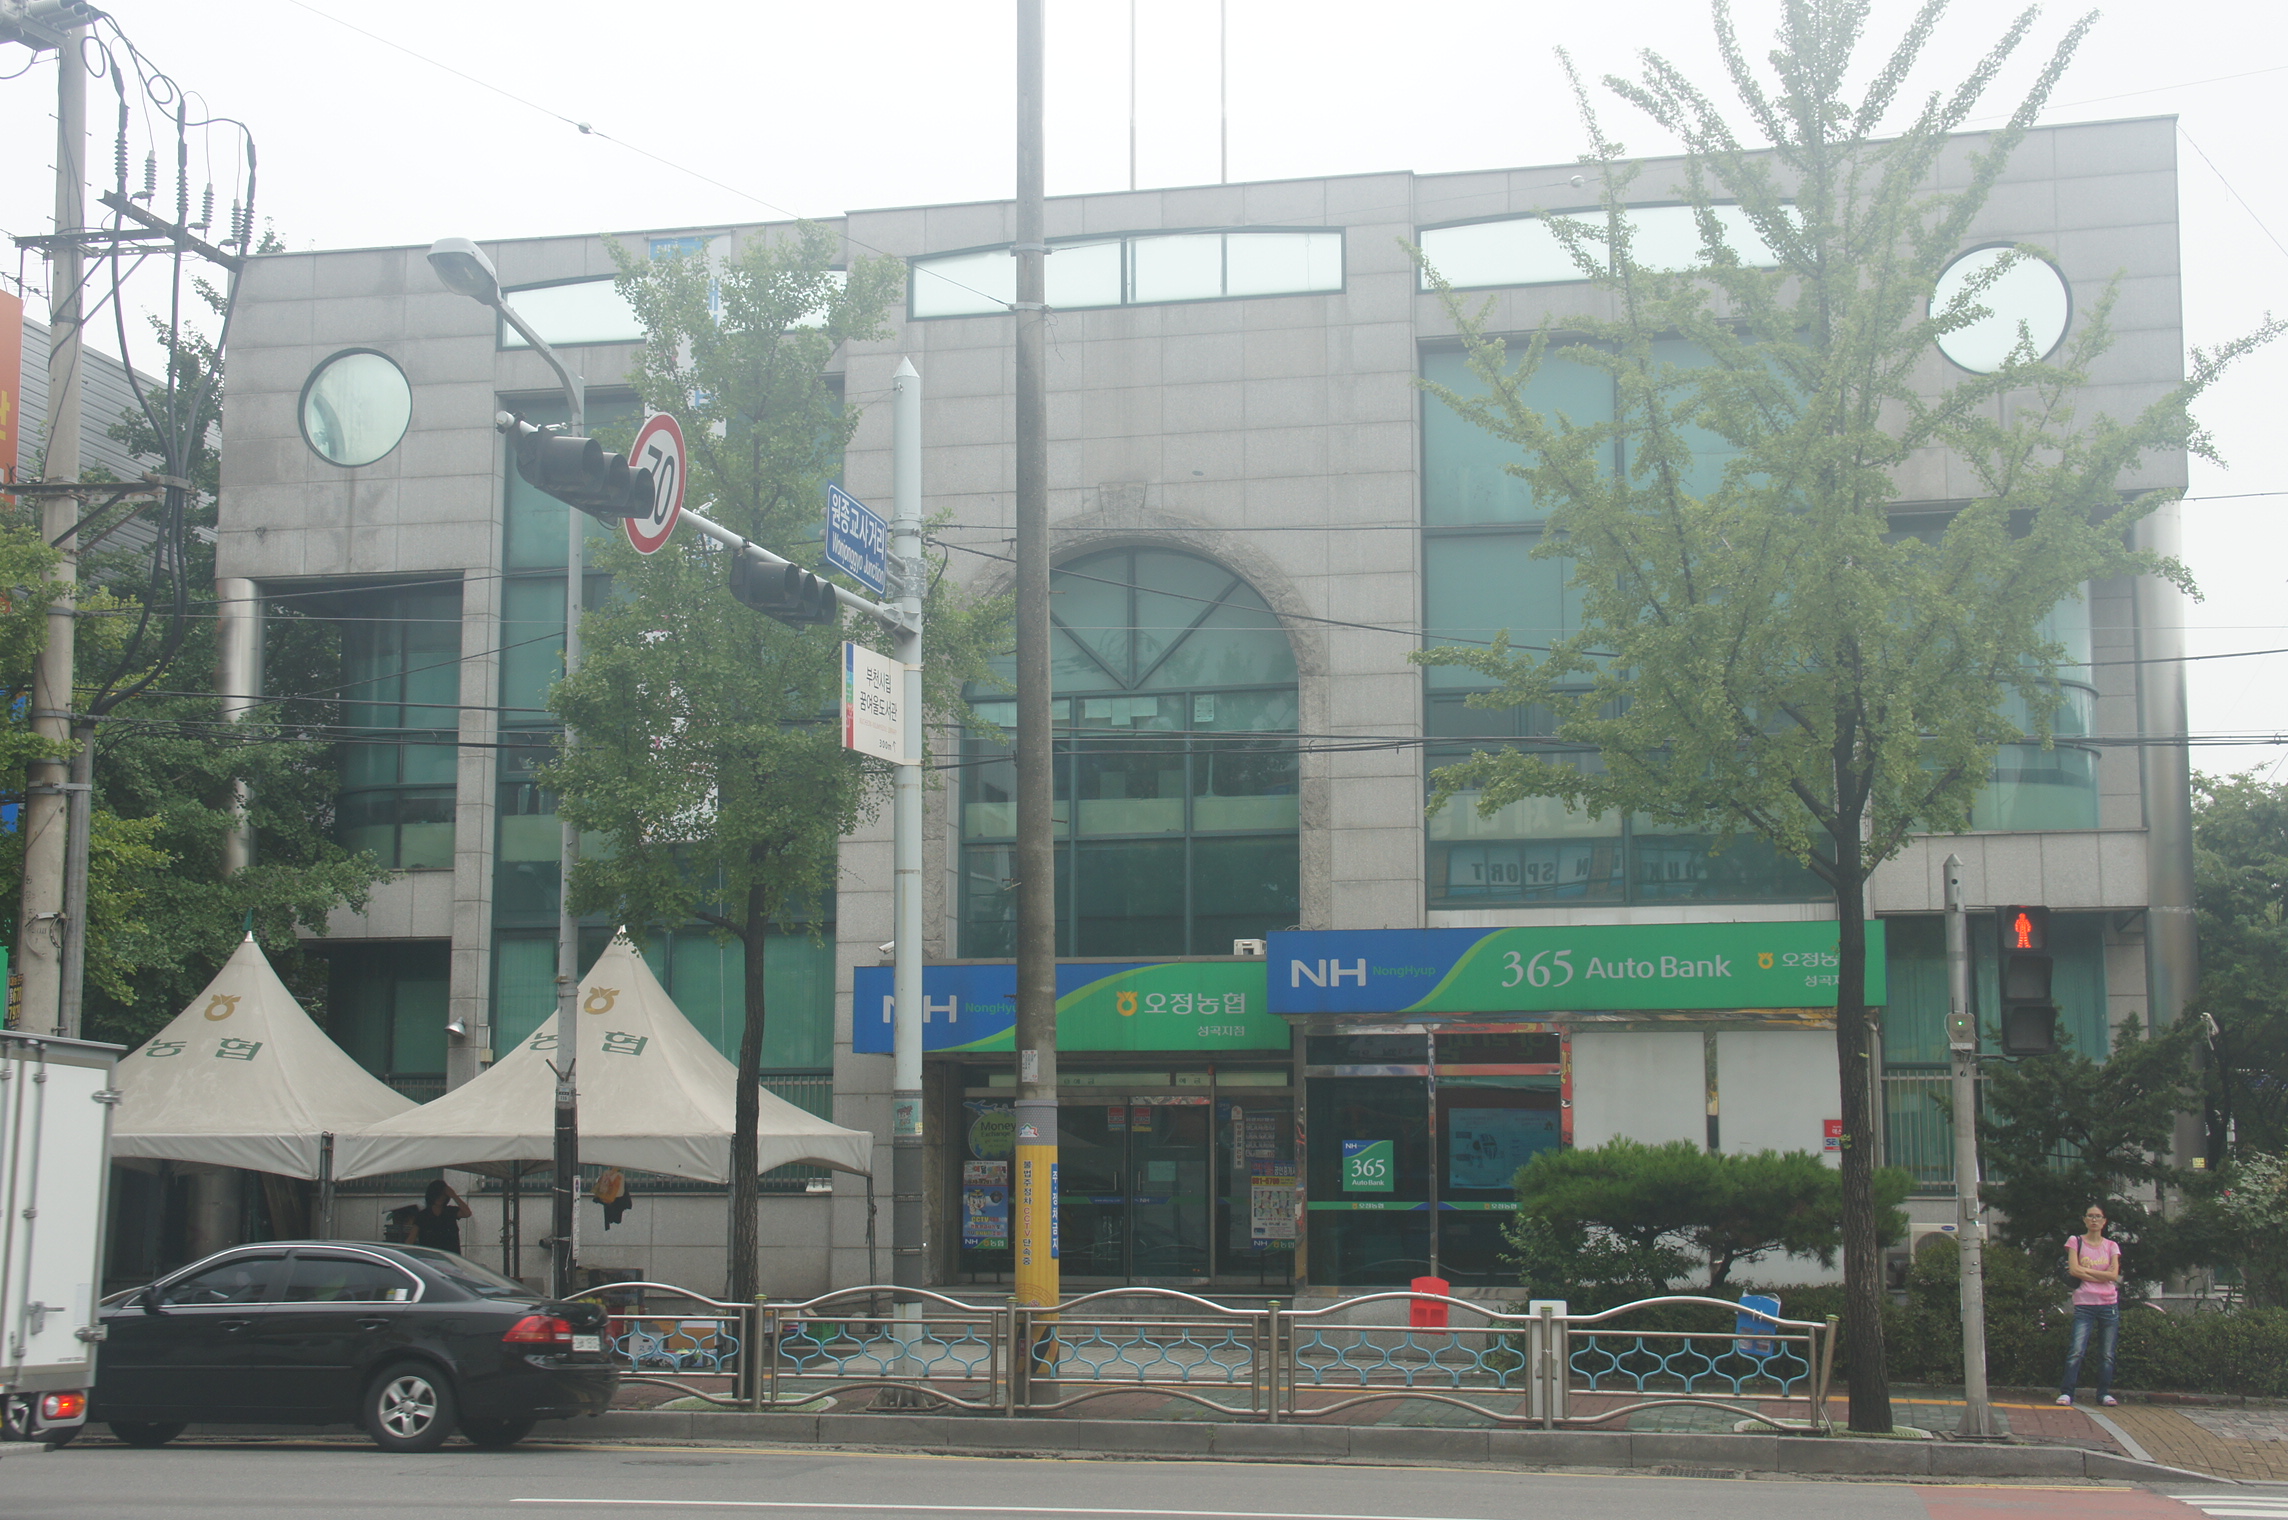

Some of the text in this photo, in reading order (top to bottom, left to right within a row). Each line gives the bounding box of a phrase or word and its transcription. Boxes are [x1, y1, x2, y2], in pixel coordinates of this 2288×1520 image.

[647, 444, 675, 526] 70
[831, 492, 886, 561] 원종교사거리
[832, 530, 885, 585] Wonjonggyo Junction
[866, 665, 892, 695] 부천시립
[860, 690, 898, 723] 꿈여울도서관
[879, 738, 892, 751] 300m
[1290, 948, 1732, 990] NH NongHyup 365 Auto Bank
[1782, 952, 1839, 967] 오정농
[964, 1001, 1016, 1016] NongHyu
[1144, 991, 1247, 1015] 오정농협
[1196, 1024, 1246, 1037] 성곡지점
[980, 1121, 1016, 1133] Money
[1351, 1157, 1385, 1178] 365
[1022, 1160, 1033, 1266] 불법주정차 CCTV 단속중
